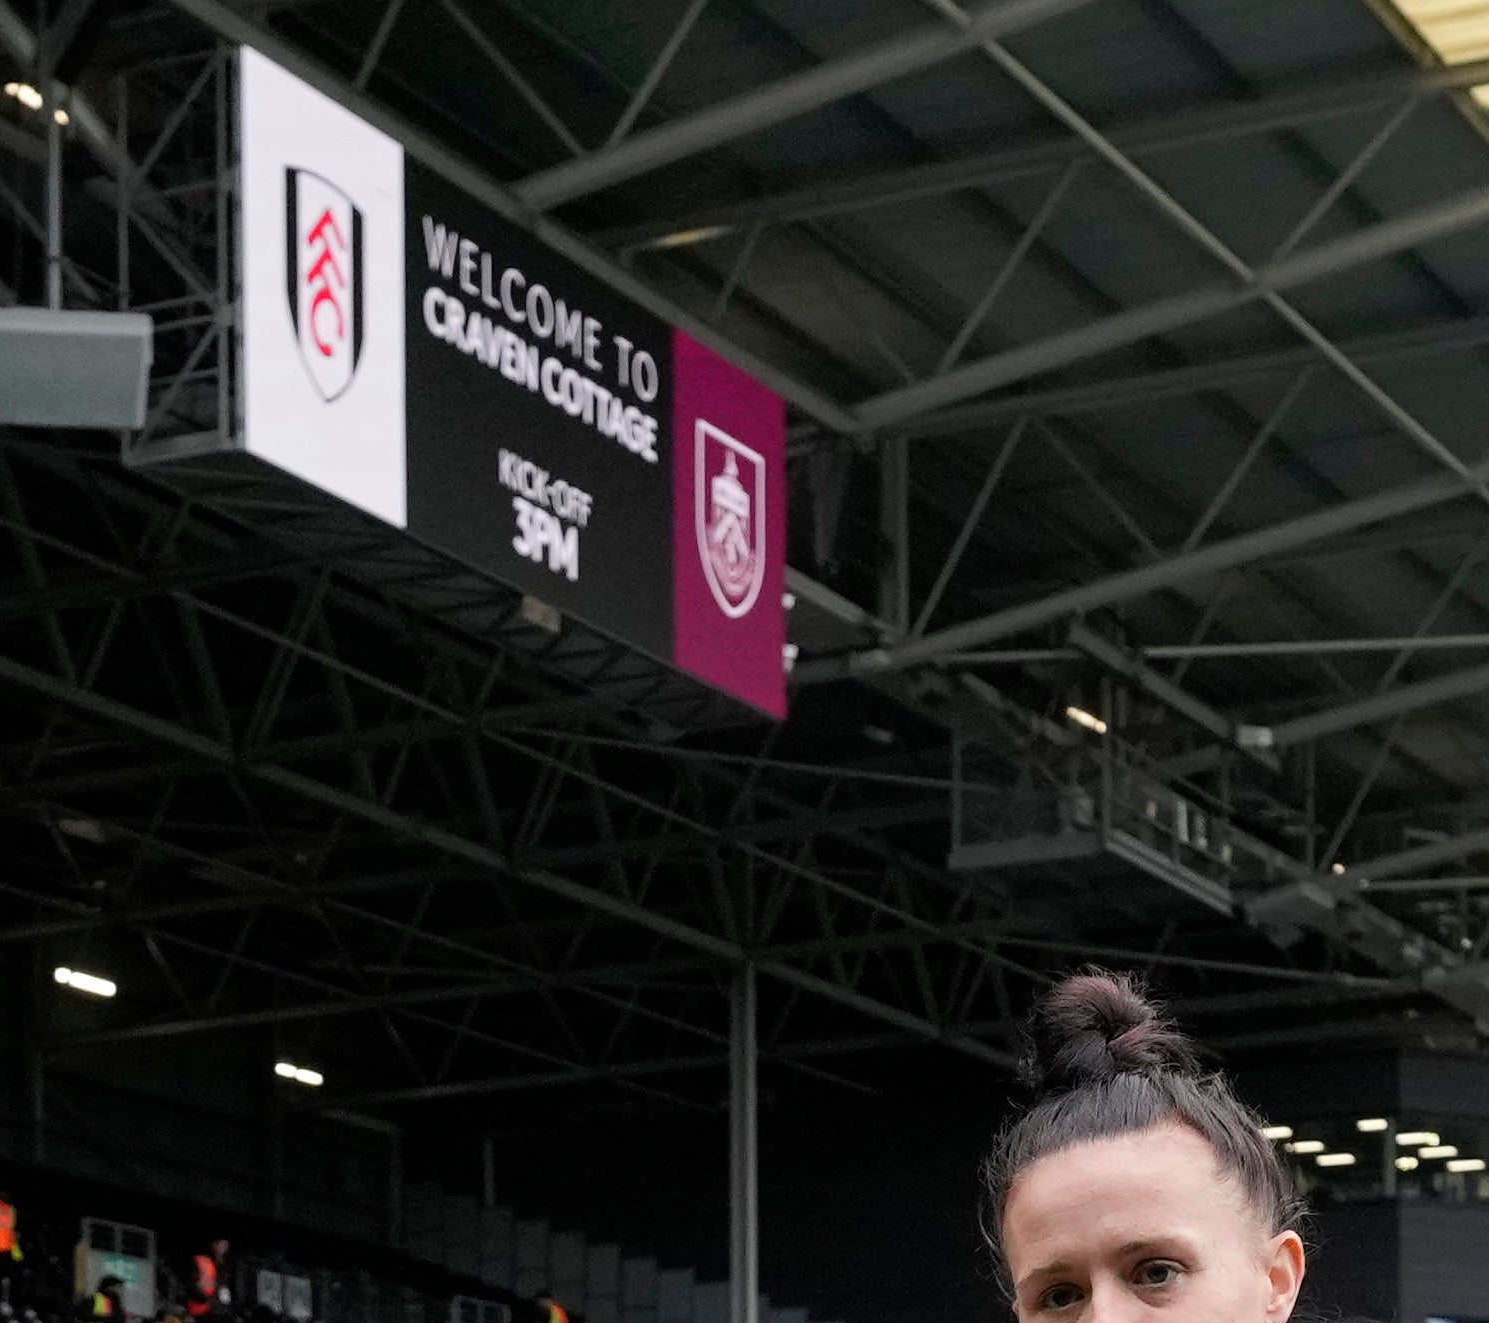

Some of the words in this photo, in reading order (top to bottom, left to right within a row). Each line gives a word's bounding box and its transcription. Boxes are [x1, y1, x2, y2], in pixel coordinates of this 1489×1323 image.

[422, 213, 603, 372] WELCOME
[613, 335, 659, 403] TO
[422, 286, 539, 392] CRAVEN
[540, 356, 659, 463] COTTAGE
[498, 448, 593, 528] KICK-OFF
[512, 495, 579, 582] 3PM
